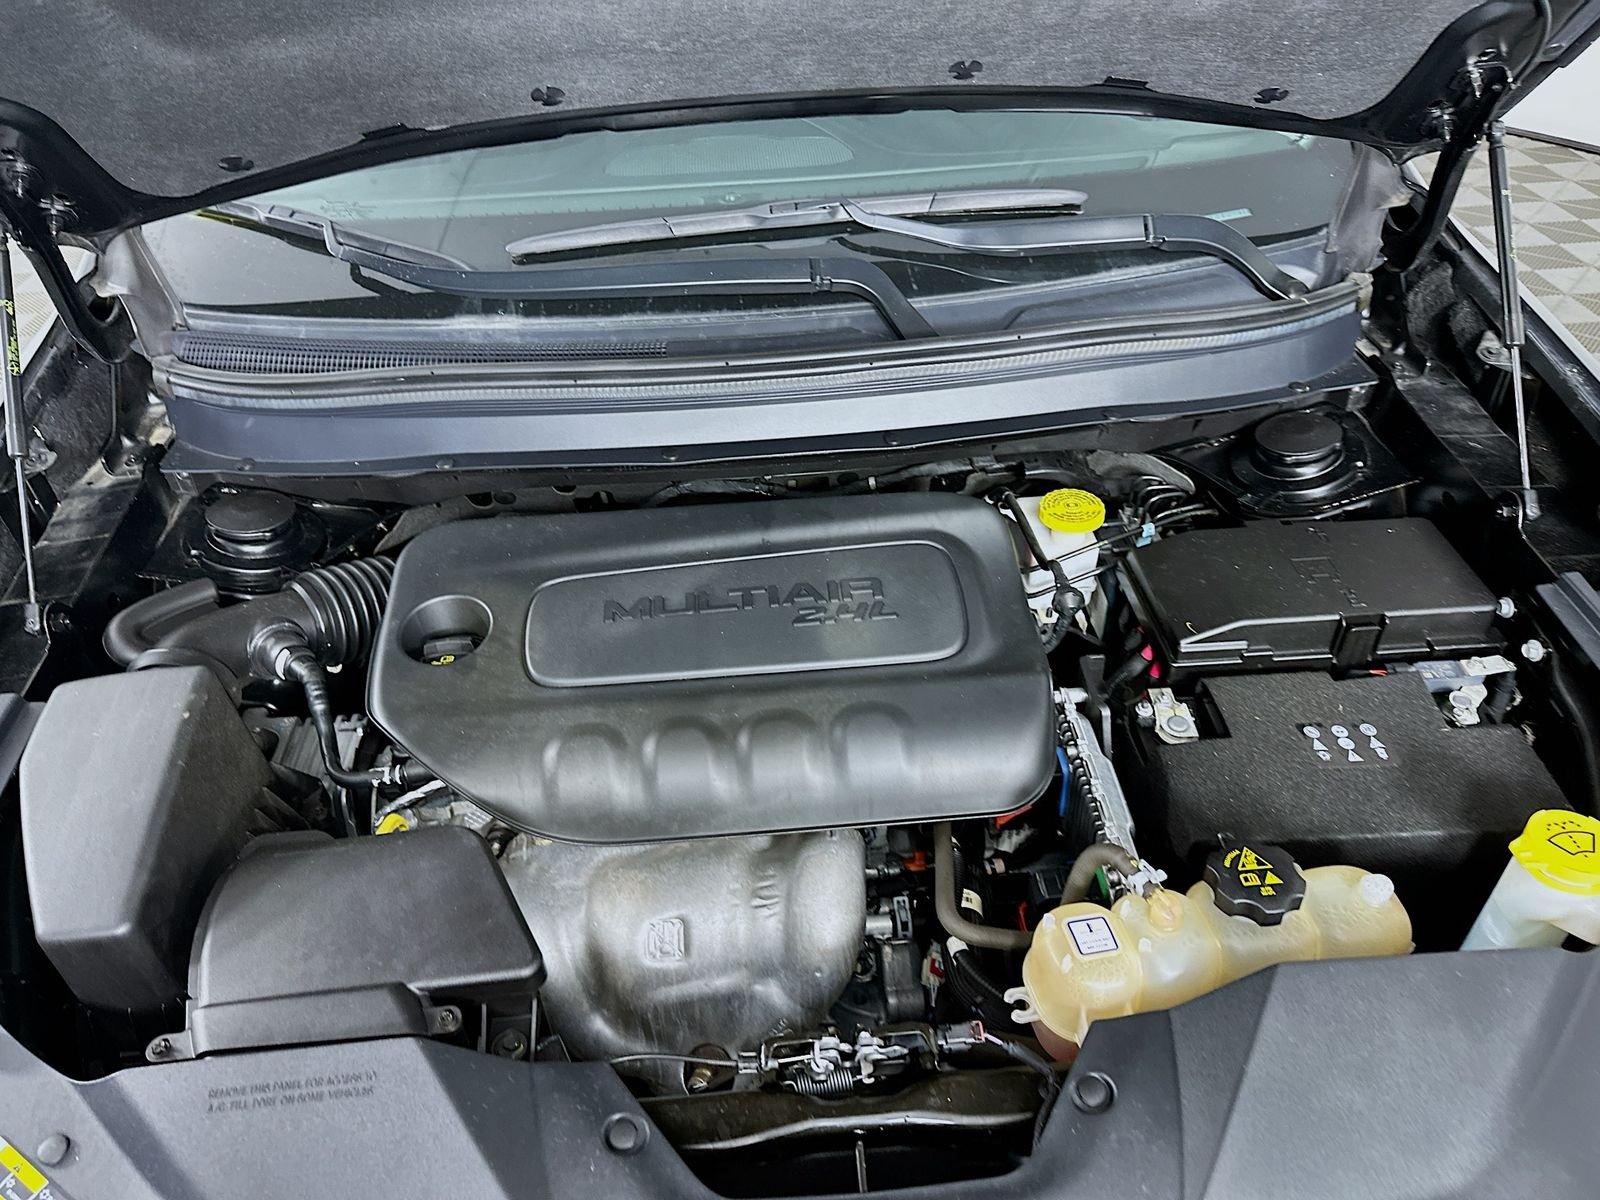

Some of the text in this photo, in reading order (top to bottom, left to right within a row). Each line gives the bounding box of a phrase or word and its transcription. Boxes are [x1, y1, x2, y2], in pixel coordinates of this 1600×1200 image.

[603, 576, 884, 623] MULTIAIR
[792, 601, 899, 627] 2.4L
[208, 1086, 247, 1099] REMOVE
[250, 1083, 271, 1095] THIS
[273, 1080, 301, 1092] PANEL
[304, 1078, 325, 1089] FOR
[229, 1100, 248, 1111] FILL
[252, 1096, 277, 1108] PORT
[280, 1094, 296, 1105] ON
[297, 1091, 325, 1103] SOME
